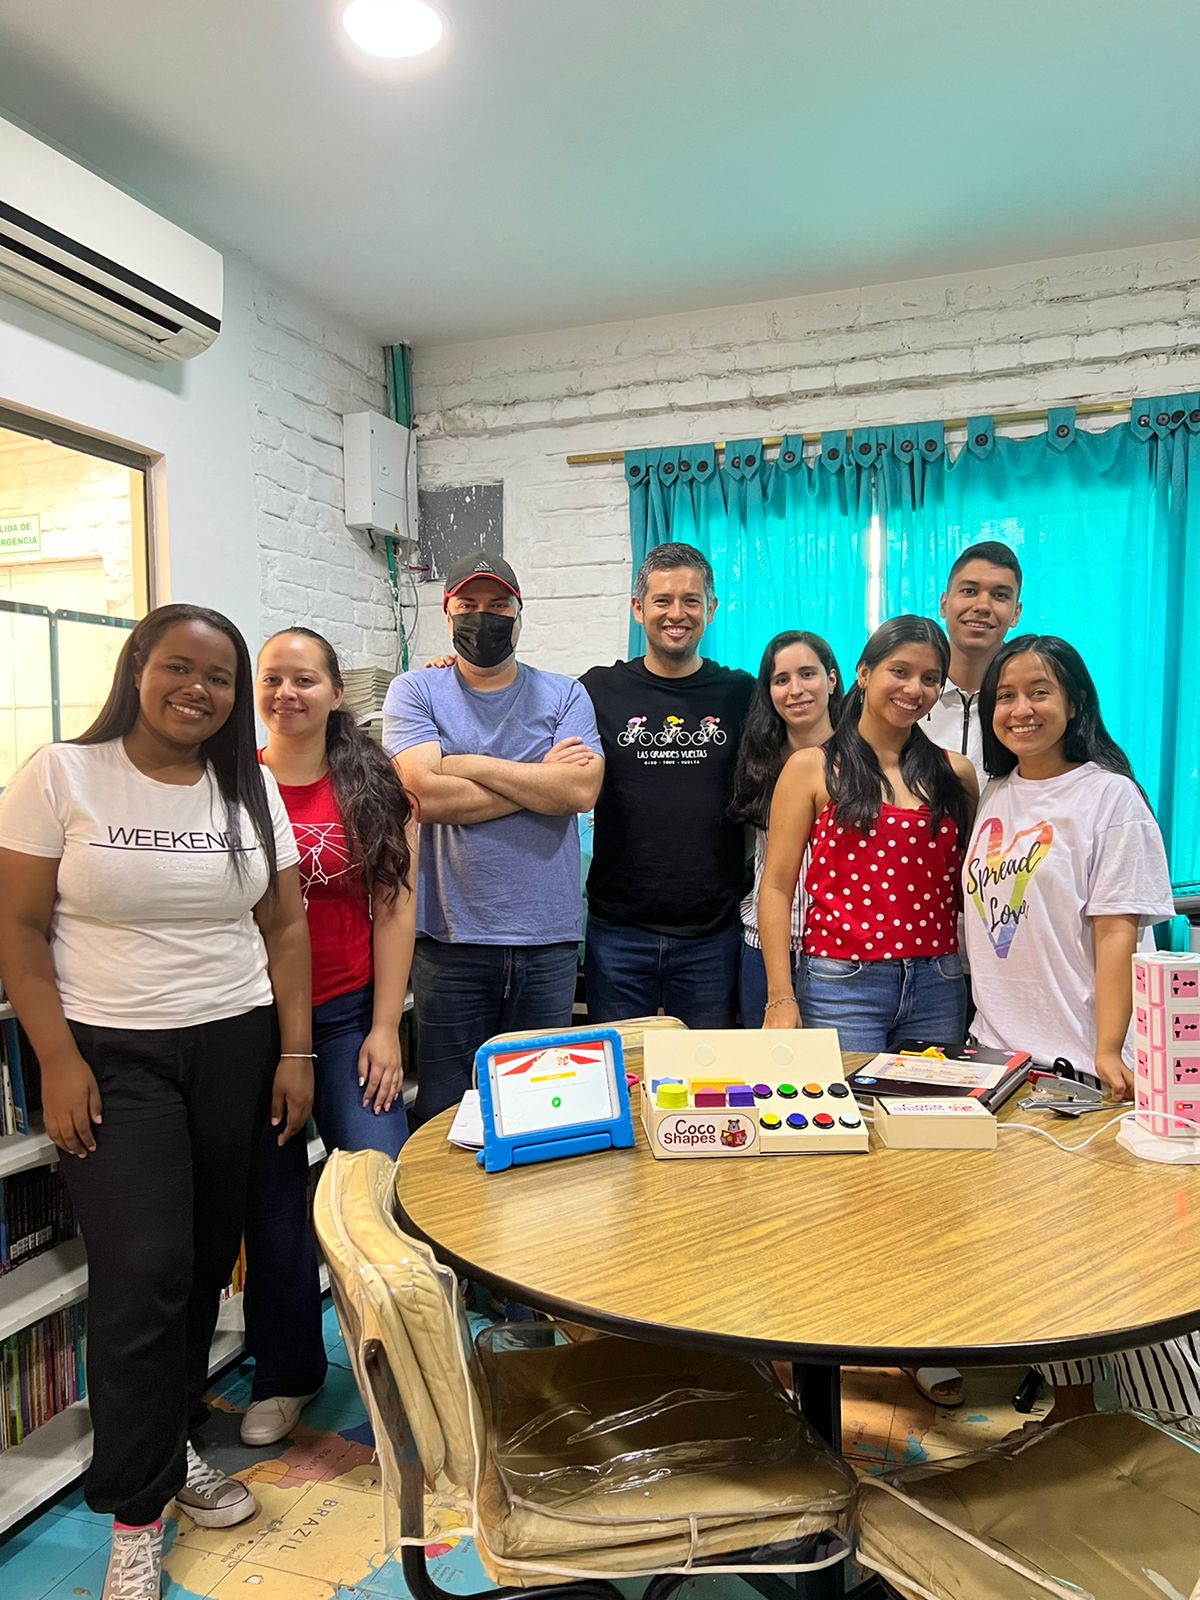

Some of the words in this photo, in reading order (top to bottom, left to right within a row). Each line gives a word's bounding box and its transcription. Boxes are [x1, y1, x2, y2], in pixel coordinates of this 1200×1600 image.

[20, 522, 31, 531] DE
[636, 750, 649, 759] LAS
[650, 750, 680, 759] GRANDES
[681, 749, 708, 758] VUELTAS
[966, 841, 1041, 902] Spread
[675, 1119, 716, 1135] Coco
[663, 1132, 716, 1147] Shapes
[278, 1499, 339, 1551] BRAZIL
